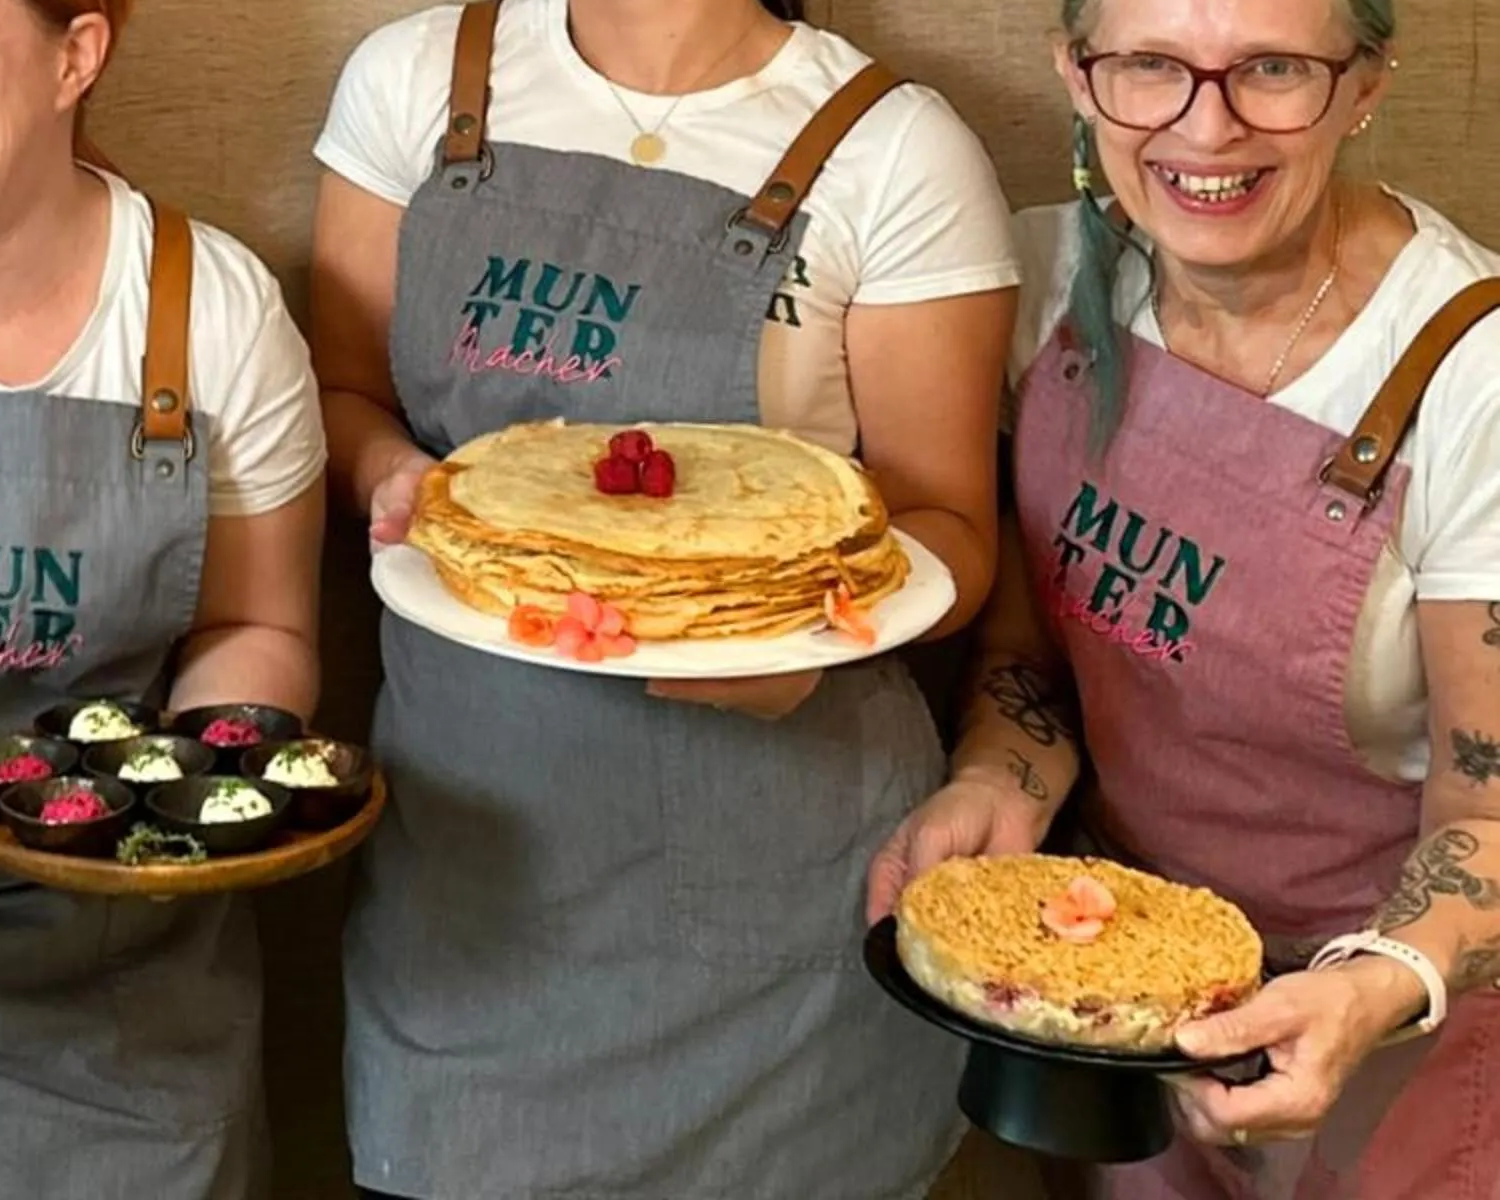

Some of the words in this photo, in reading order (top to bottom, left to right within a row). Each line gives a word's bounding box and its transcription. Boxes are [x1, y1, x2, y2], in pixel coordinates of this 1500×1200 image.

[469, 256, 642, 322] MUN
[461, 302, 617, 378] TER
[1061, 479, 1226, 606] MUN
[1053, 533, 1190, 663] TER
